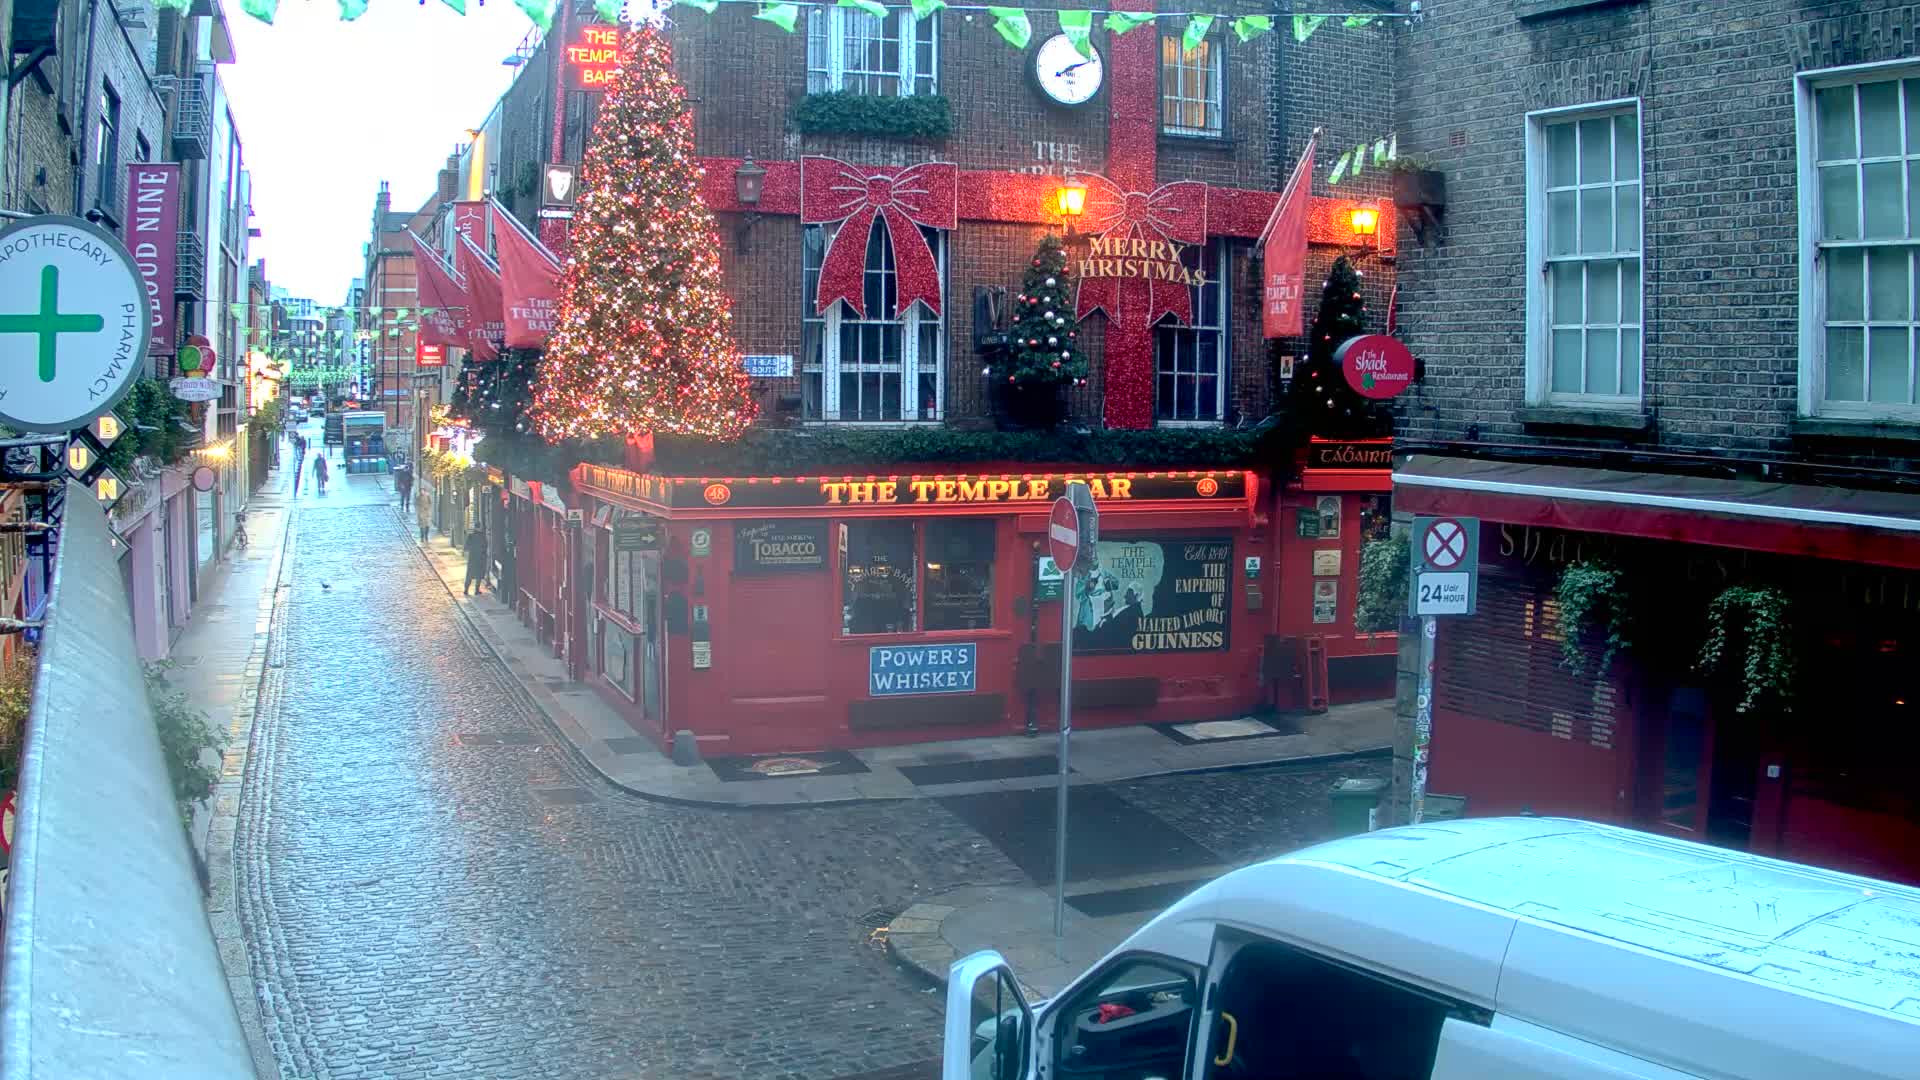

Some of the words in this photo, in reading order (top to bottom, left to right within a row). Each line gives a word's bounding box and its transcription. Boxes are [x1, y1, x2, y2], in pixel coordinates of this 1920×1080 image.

[583, 30, 617, 45] THE
[1032, 141, 1081, 163] THE
[136, 171, 169, 232] NINE
[1088, 237, 1185, 263] MERRY
[1074, 259, 1207, 287] HRISTMAS
[87, 303, 137, 401] PHARMACY
[752, 366, 777, 374] SOUTH
[593, 468, 606, 488] THE
[607, 472, 633, 495] TEMPLE
[635, 477, 651, 497] BAR
[822, 481, 898, 503] THE
[911, 479, 1049, 502] TEMPLE
[1064, 478, 1132, 498] AR
[1199, 481, 1213, 493] 48
[708, 487, 725, 500] 48
[752, 539, 816, 560] TOBACCO
[1121, 546, 1144, 558] THE
[1112, 557, 1156, 569] TEMPLE
[1202, 563, 1225, 578] THE
[1121, 568, 1144, 579] BAR
[1176, 578, 1225, 593] EMPEROR
[1421, 584, 1443, 603] 24
[1211, 593, 1225, 608] OF
[1443, 594, 1465, 602] HOUR
[1135, 616, 1181, 632] MALTED
[1183, 608, 1225, 630] LIQUORS
[1132, 631, 1223, 650] GUINNESS
[879, 648, 969, 667] POWER'S
[873, 671, 973, 690] WHISKEY
